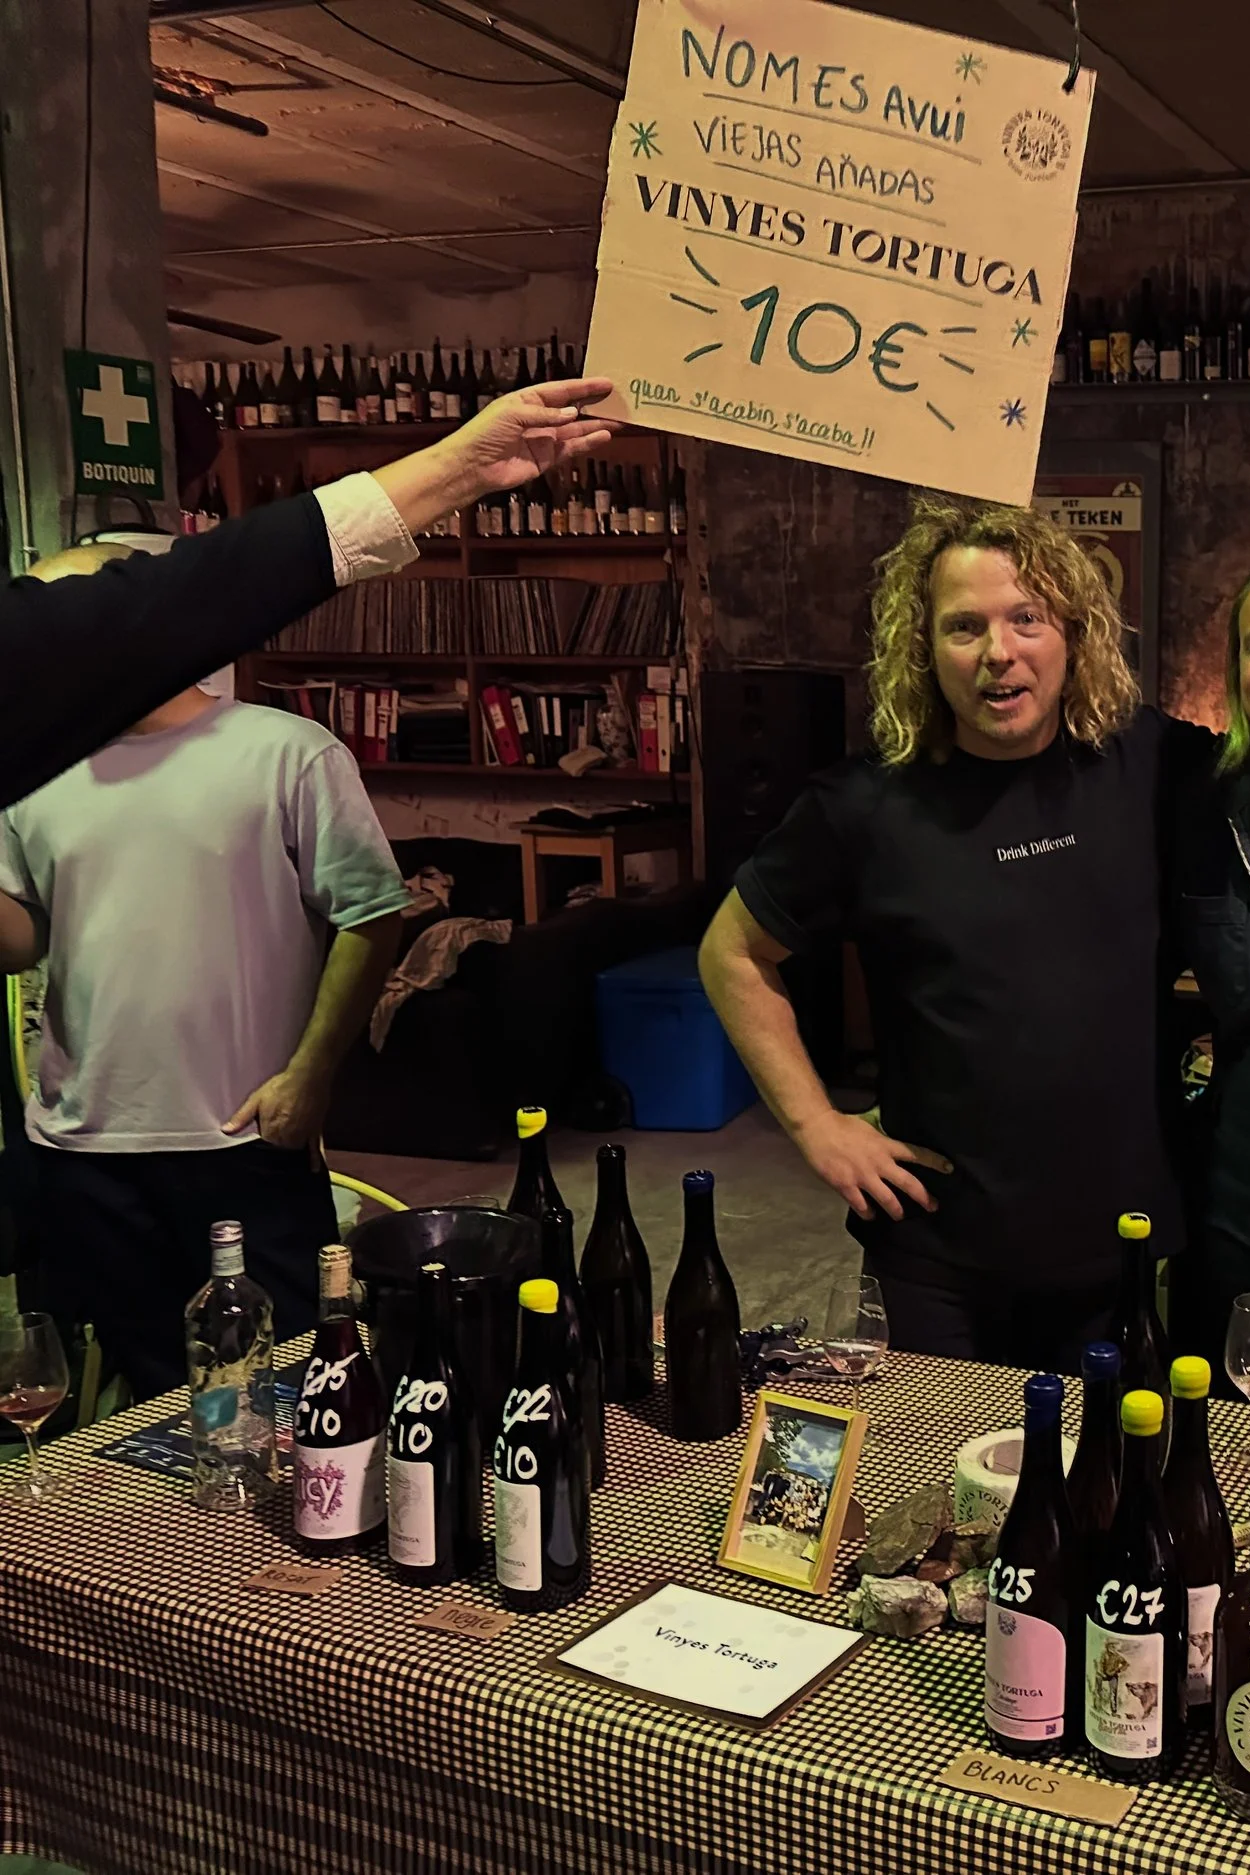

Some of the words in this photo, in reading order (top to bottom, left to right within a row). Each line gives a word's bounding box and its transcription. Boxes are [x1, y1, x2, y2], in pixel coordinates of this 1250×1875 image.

[634, 174, 807, 247] VINYES
[822, 219, 1043, 306] TORTUGA
[740, 285, 928, 394] 10€
[630, 378, 680, 410] quan
[996, 842, 1029, 862] Drink
[1029, 833, 1076, 855] Different
[440, 1608, 497, 1631] negre
[1096, 1579, 1166, 1627] €27
[655, 1626, 710, 1648] Vinyes
[714, 1643, 778, 1670] Tortuga
[962, 1759, 1061, 1794] BLANCS
